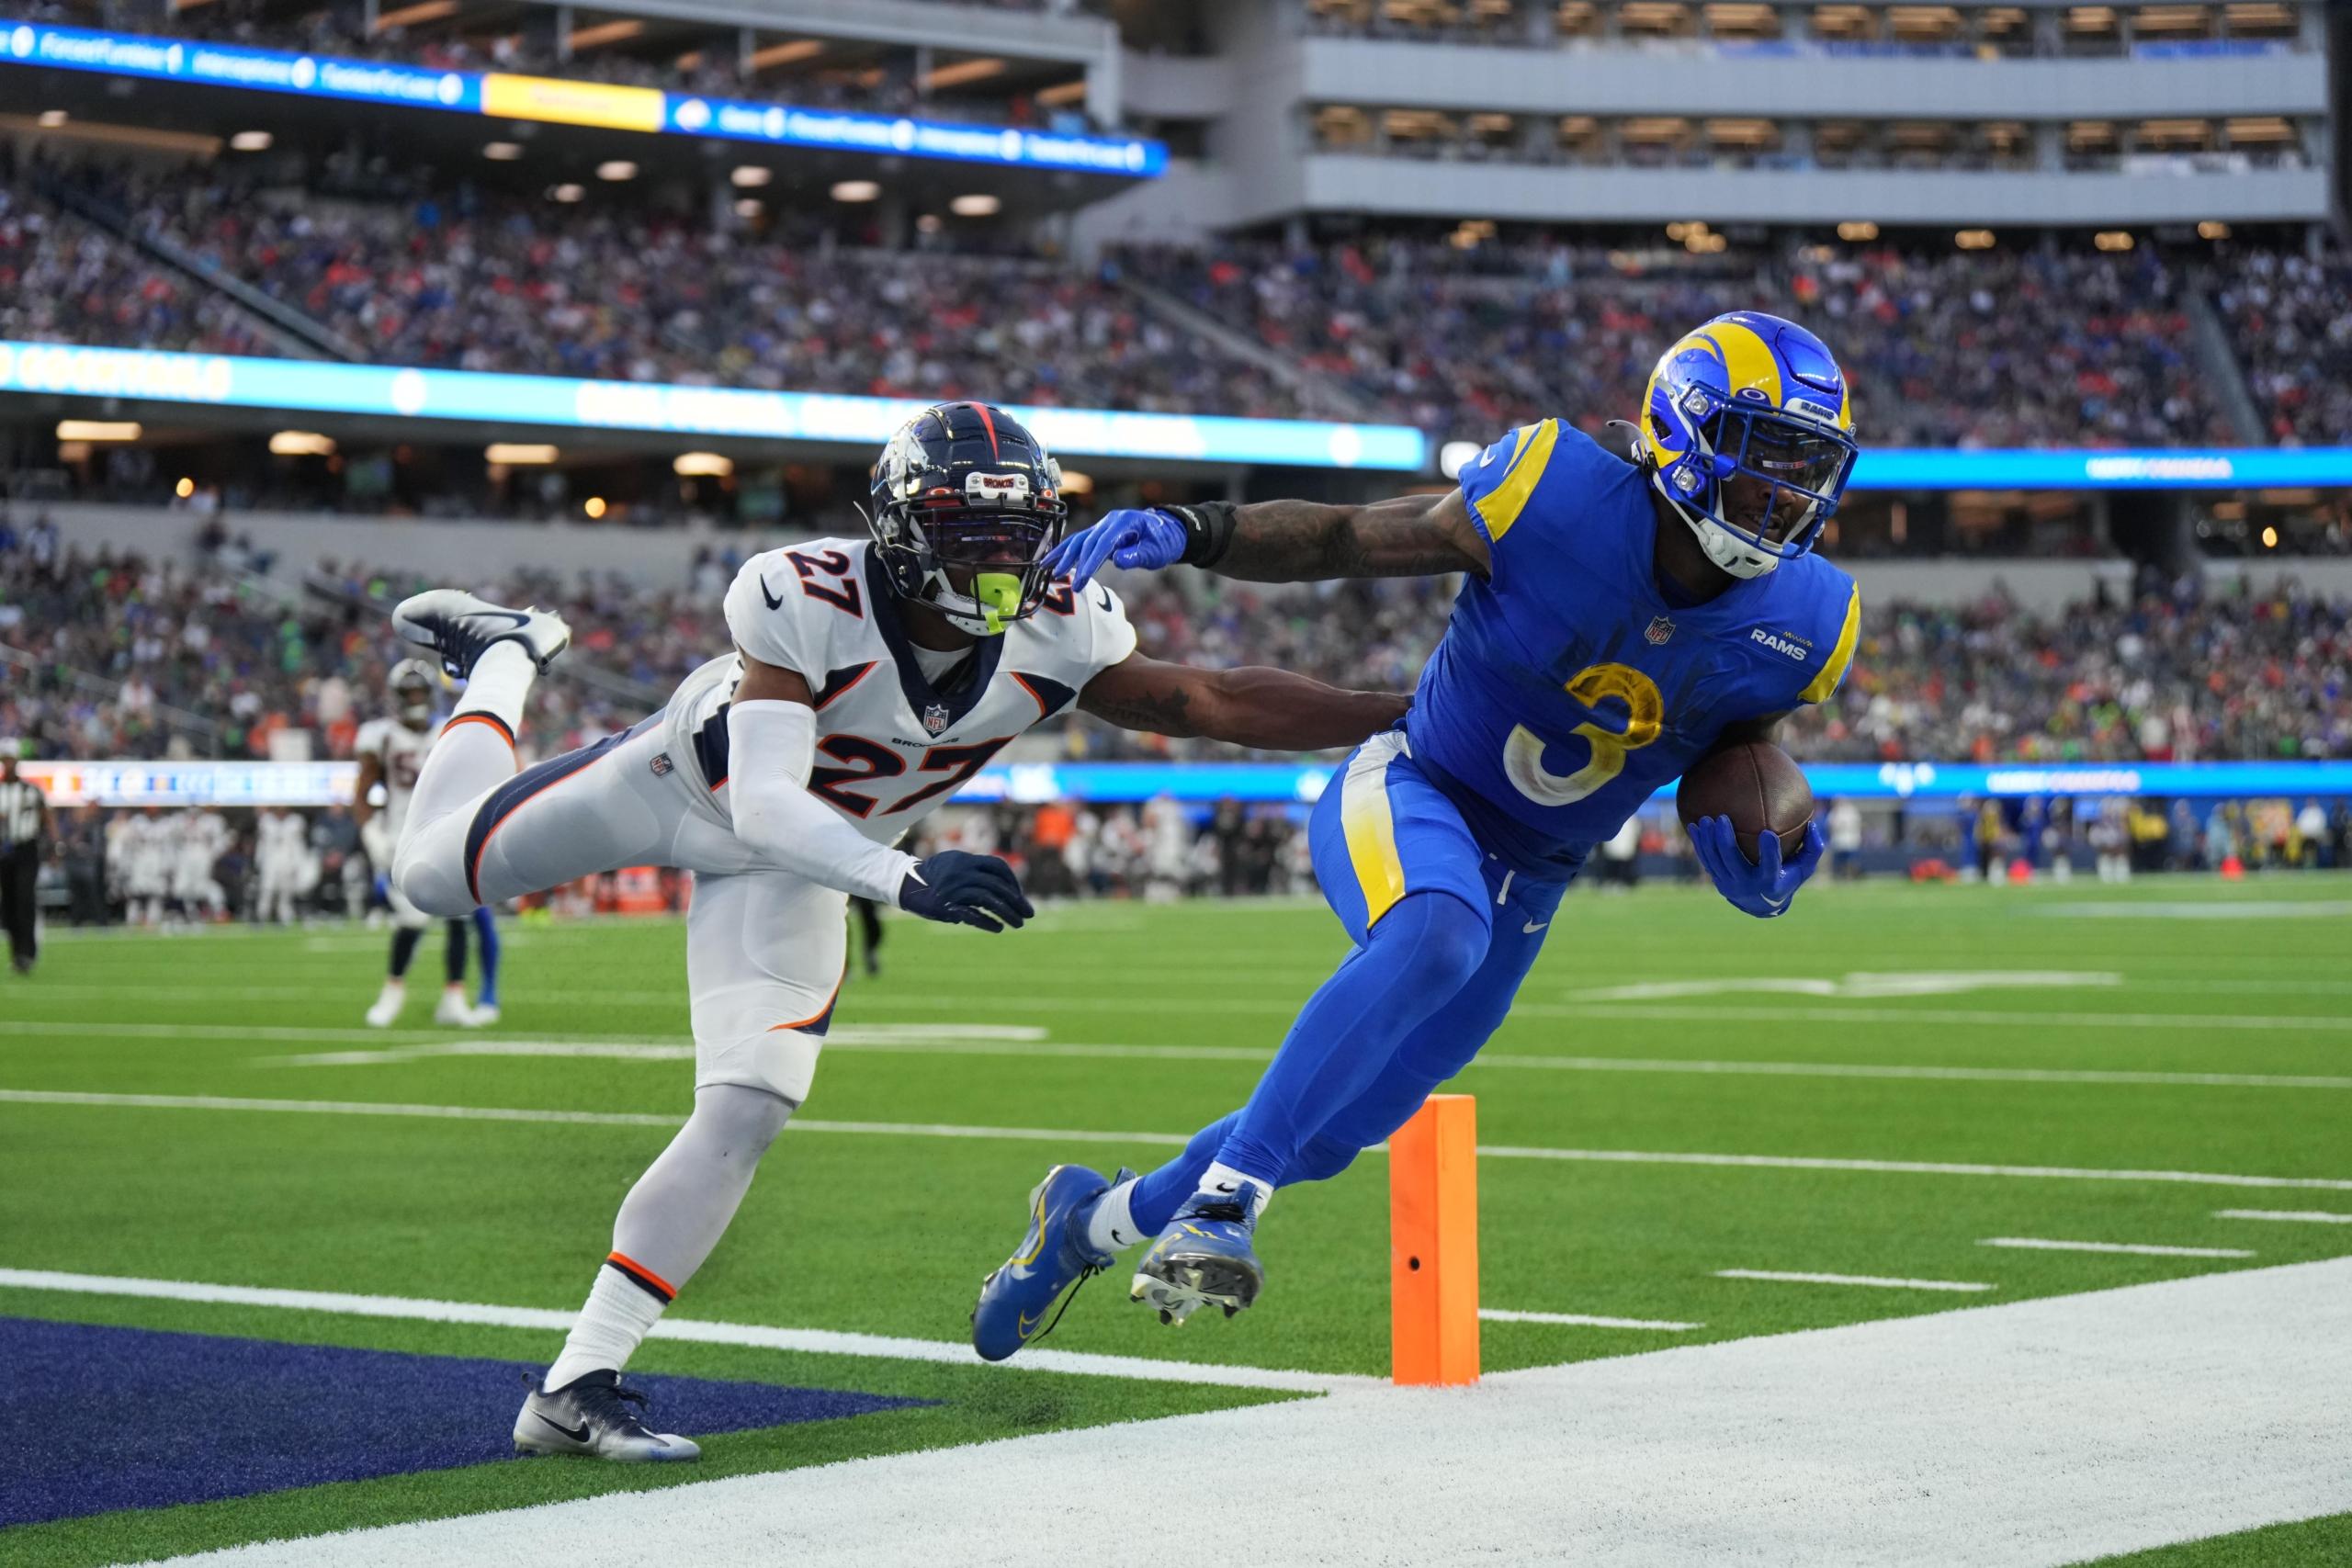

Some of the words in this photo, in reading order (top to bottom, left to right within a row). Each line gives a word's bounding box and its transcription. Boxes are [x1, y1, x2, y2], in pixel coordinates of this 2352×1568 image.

[1801, 401, 1835, 421] RAMS
[983, 477, 1014, 489] BRONCOS
[784, 549, 864, 619] 27
[1750, 628, 1807, 660] RAMS
[926, 716, 944, 730] NFL
[1502, 662, 1665, 807] 3
[805, 732, 1022, 819] 27
